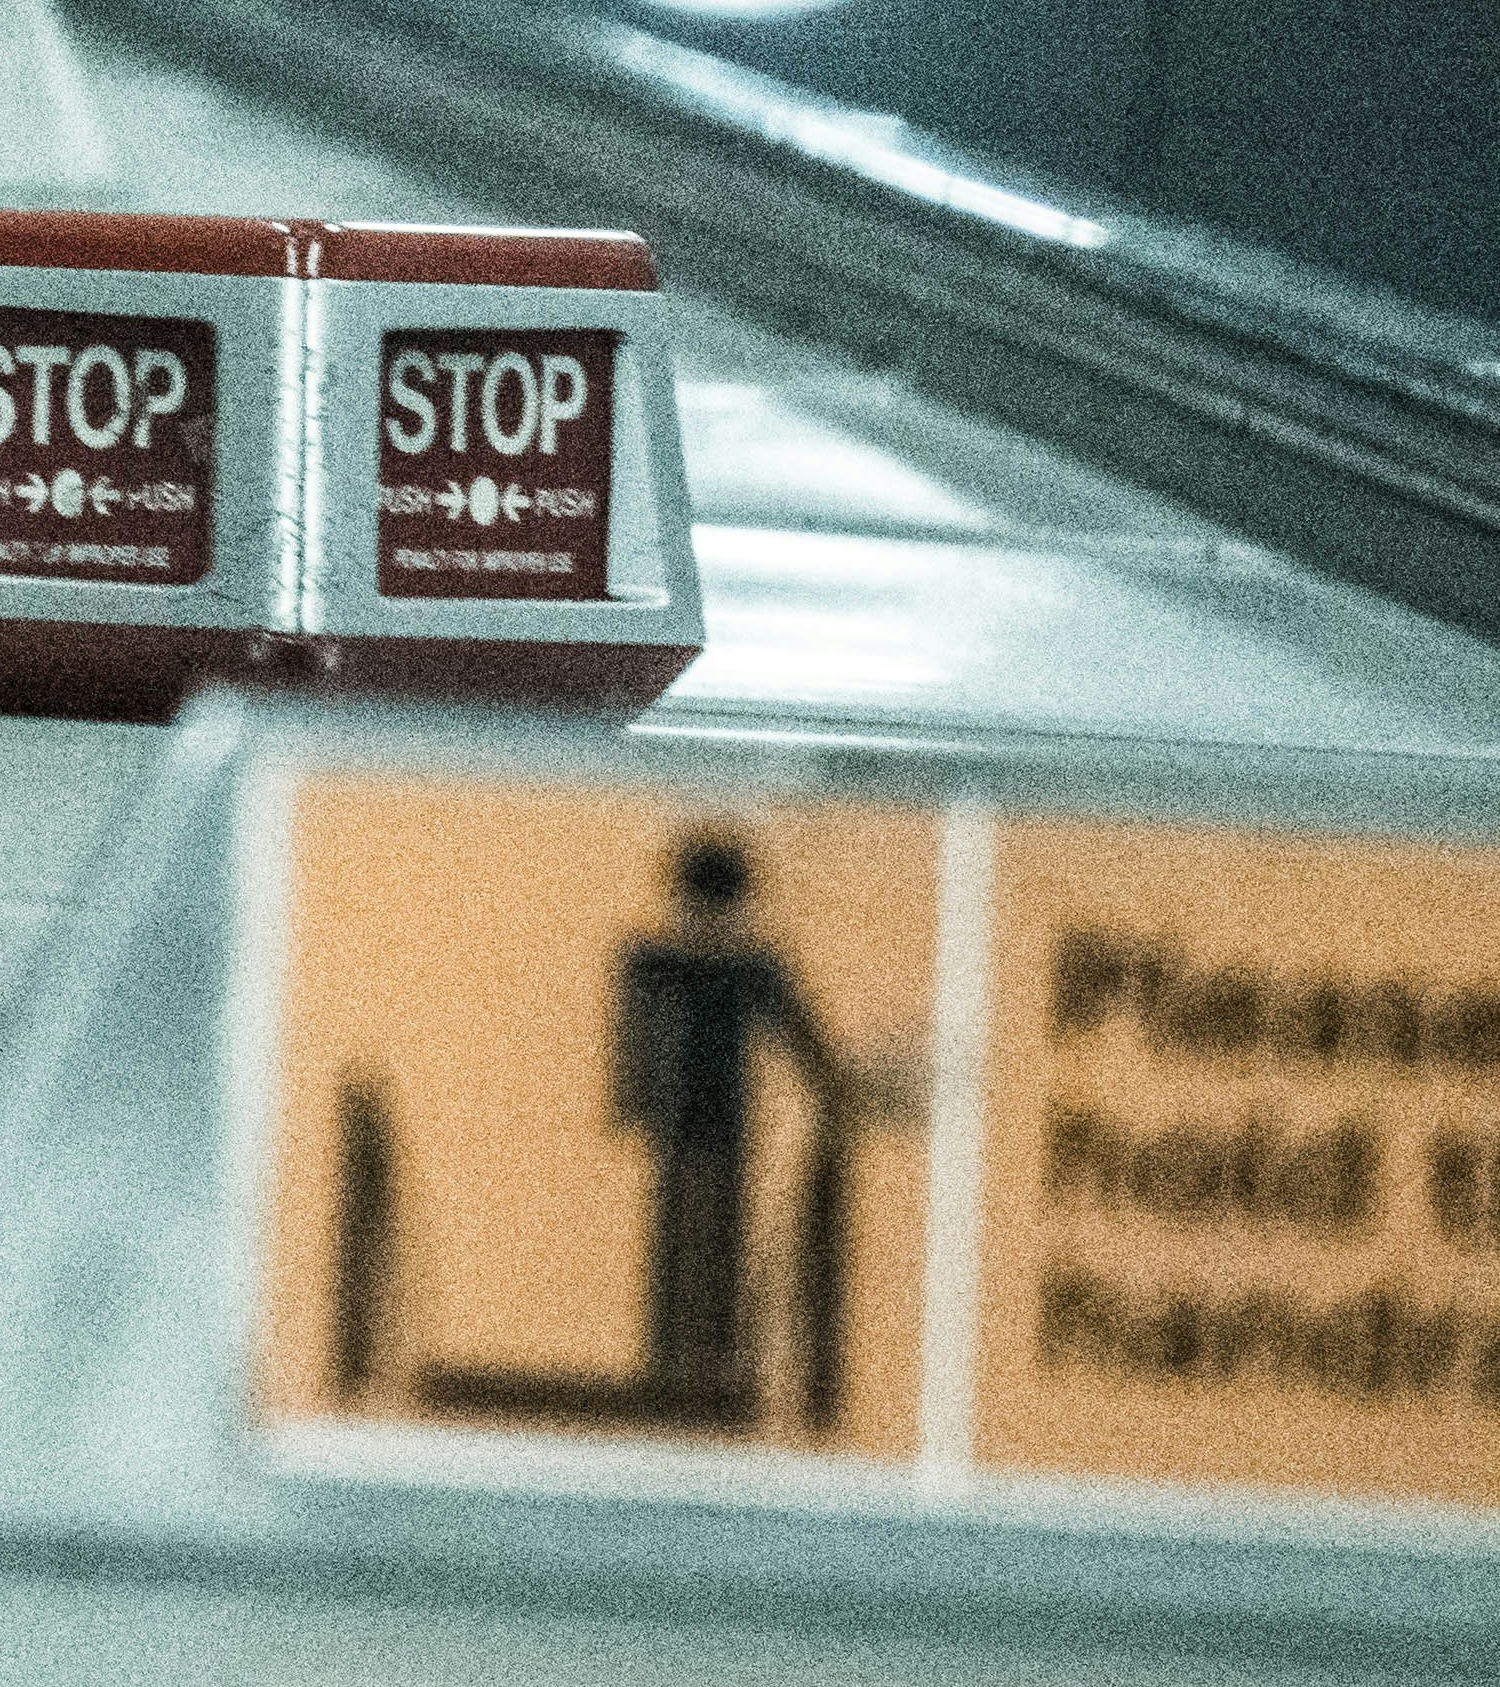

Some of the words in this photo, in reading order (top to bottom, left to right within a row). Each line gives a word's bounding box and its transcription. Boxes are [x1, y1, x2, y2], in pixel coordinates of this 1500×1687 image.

[386, 350, 588, 455] STOP
[535, 487, 595, 518] PUSH
[1043, 1099, 1378, 1239] hold
